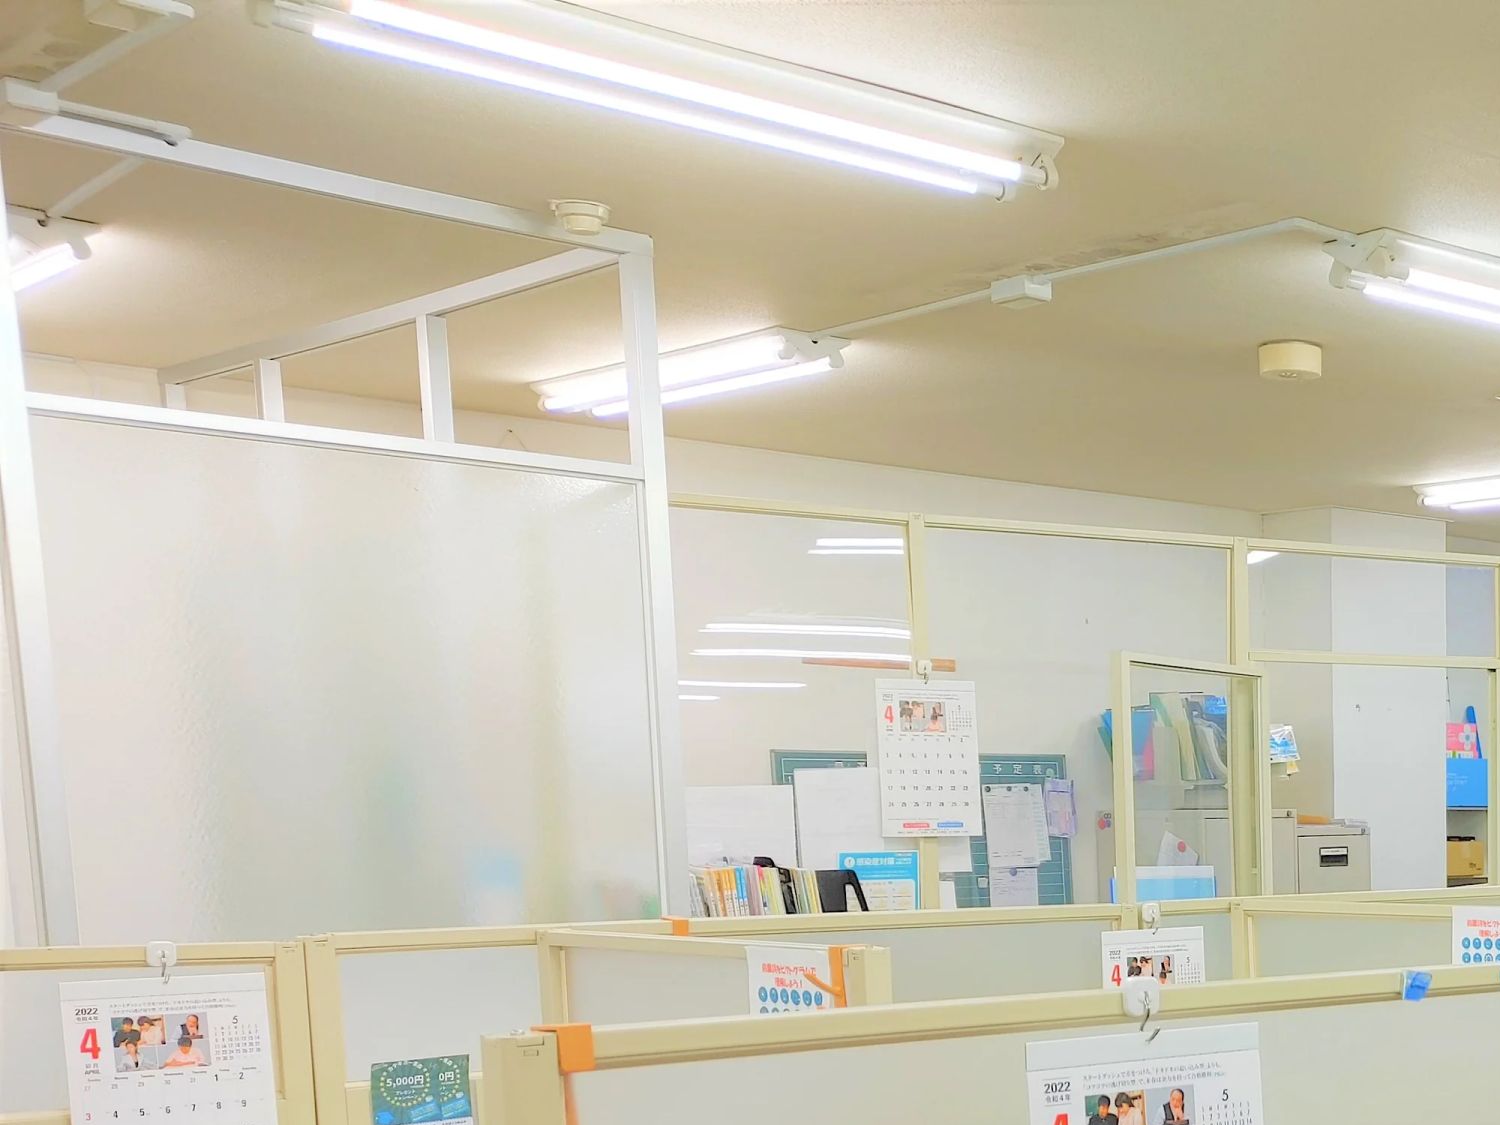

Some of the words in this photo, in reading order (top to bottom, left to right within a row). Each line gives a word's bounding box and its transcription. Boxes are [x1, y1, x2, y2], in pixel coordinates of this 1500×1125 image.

[885, 705, 894, 723] 4
[1111, 964, 1122, 987] 4
[232, 1016, 238, 1024] 5
[80, 1028, 101, 1060] 4
[214, 1074, 219, 1082] 1
[238, 1072, 244, 1080] 2
[386, 1074, 424, 1088] 5,000円
[1044, 1082, 1070, 1093] 2022
[1222, 1089, 1228, 1101] 5
[112, 1110, 118, 1119] 4
[191, 1103, 196, 1112] 7
